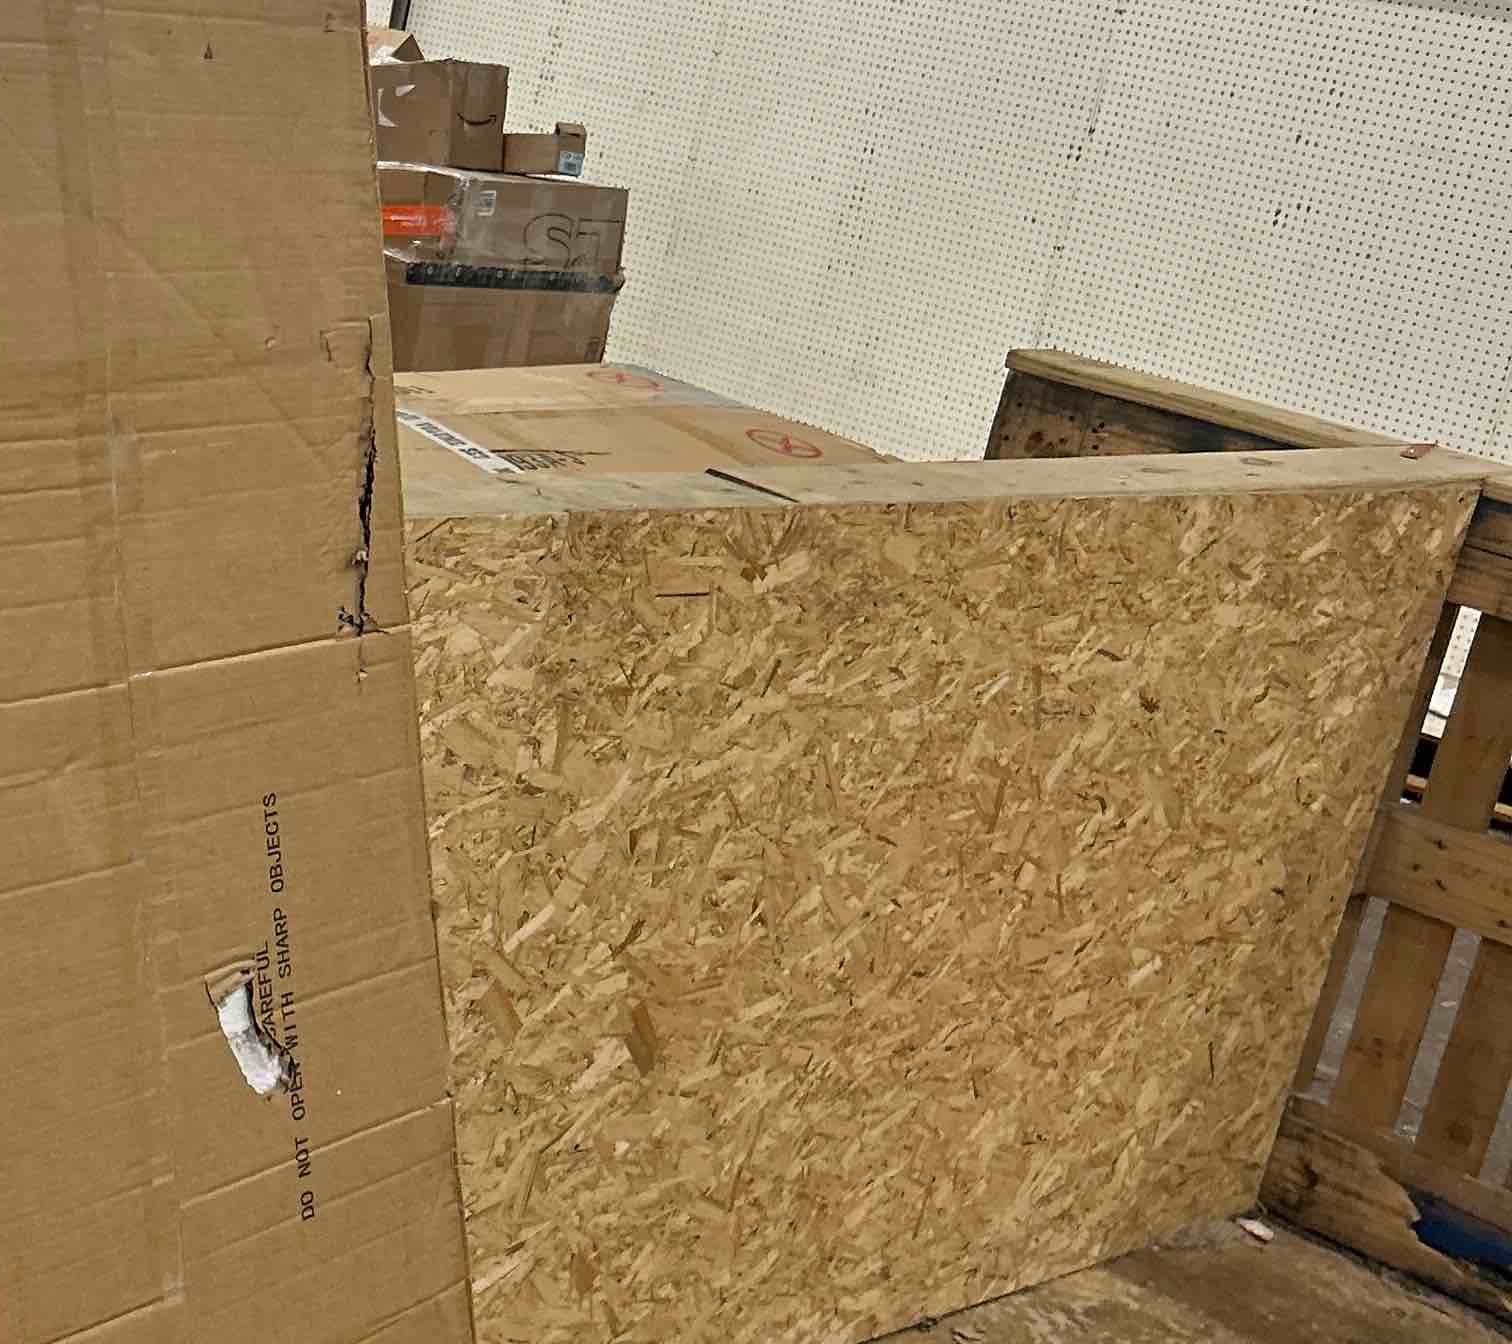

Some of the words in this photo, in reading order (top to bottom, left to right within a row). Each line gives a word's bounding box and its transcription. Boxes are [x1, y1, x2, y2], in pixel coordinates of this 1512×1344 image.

[262, 791, 285, 893] OBJECTS
[273, 907, 292, 979] SHARP
[281, 991, 298, 1050] WITH
[295, 1136, 312, 1179] NOT
[300, 1190, 316, 1221] DO
